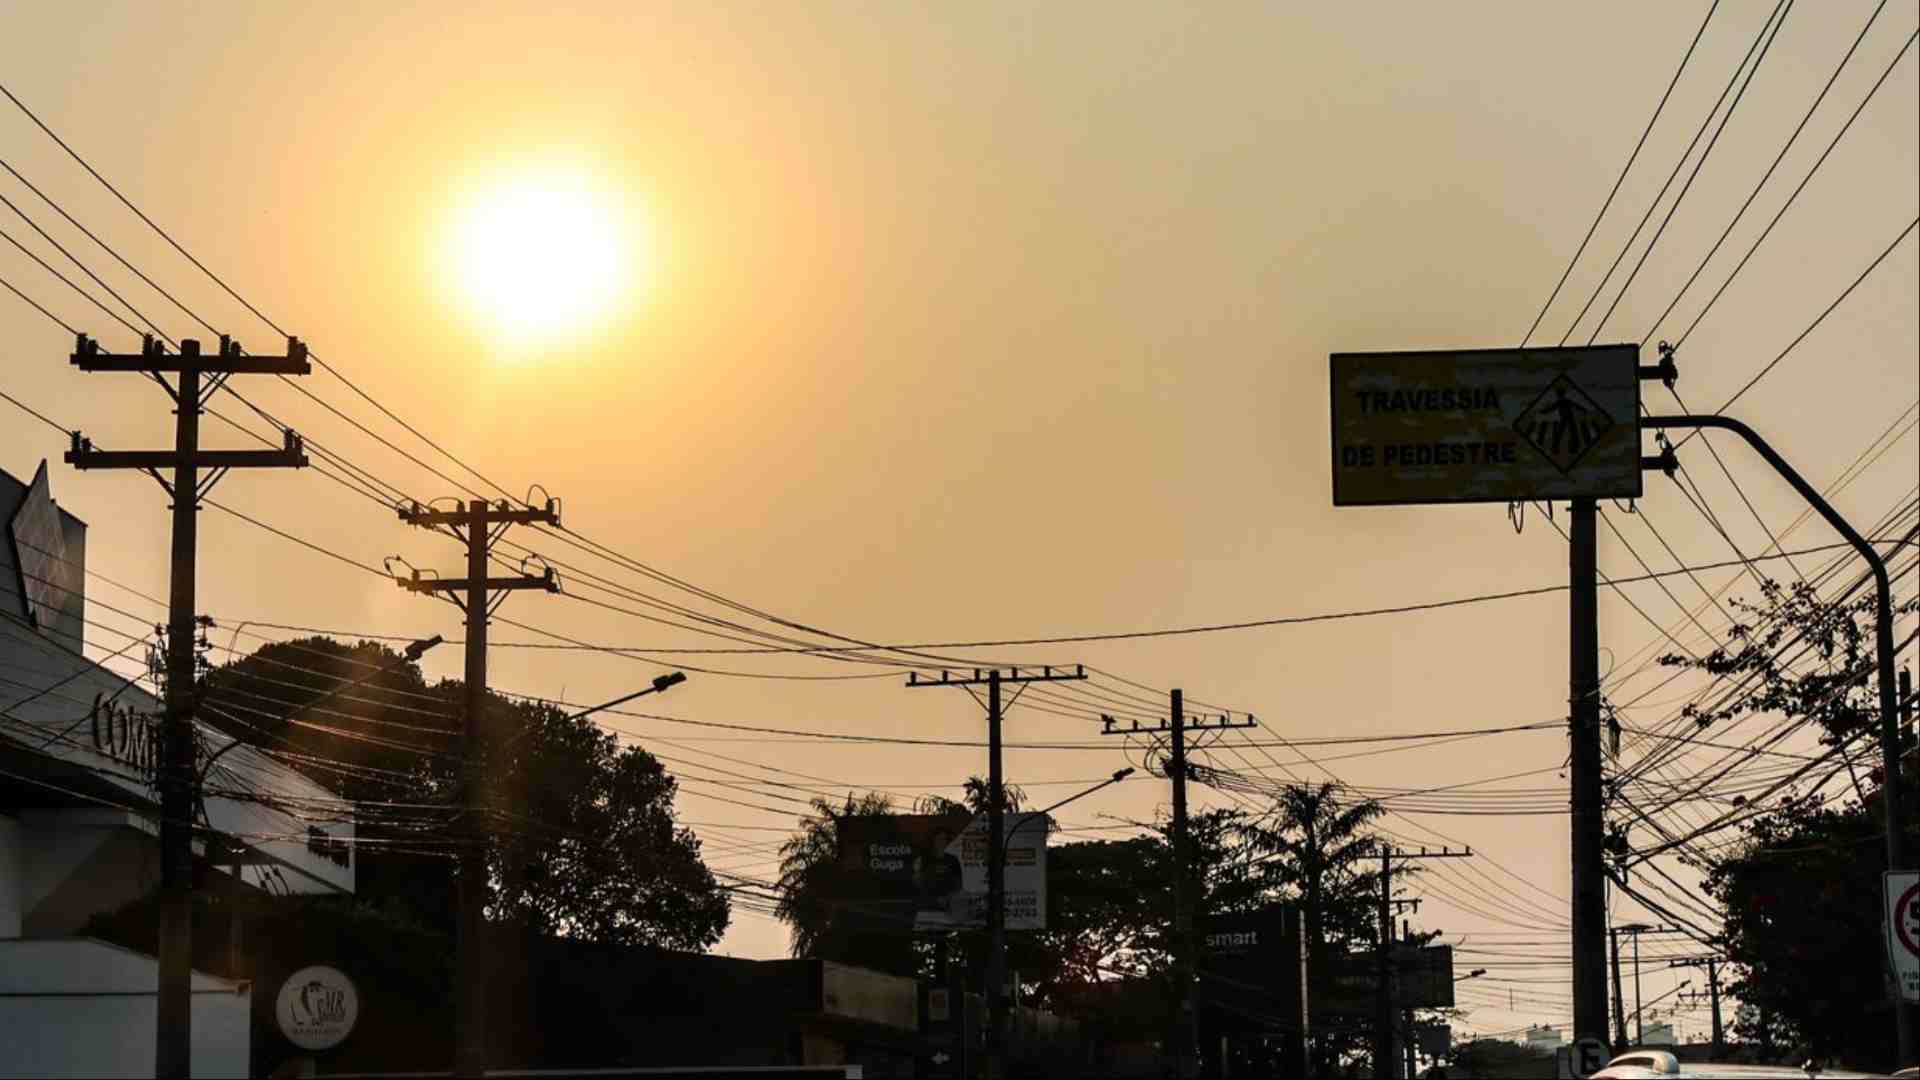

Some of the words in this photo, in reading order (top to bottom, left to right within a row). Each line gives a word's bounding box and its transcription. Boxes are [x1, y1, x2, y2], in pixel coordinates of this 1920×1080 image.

[1356, 388, 1500, 413] TRAVESSIA
[1343, 445, 1374, 467] DE
[1383, 441, 1517, 467] PEDESTRE
[1205, 930, 1258, 947] smart
